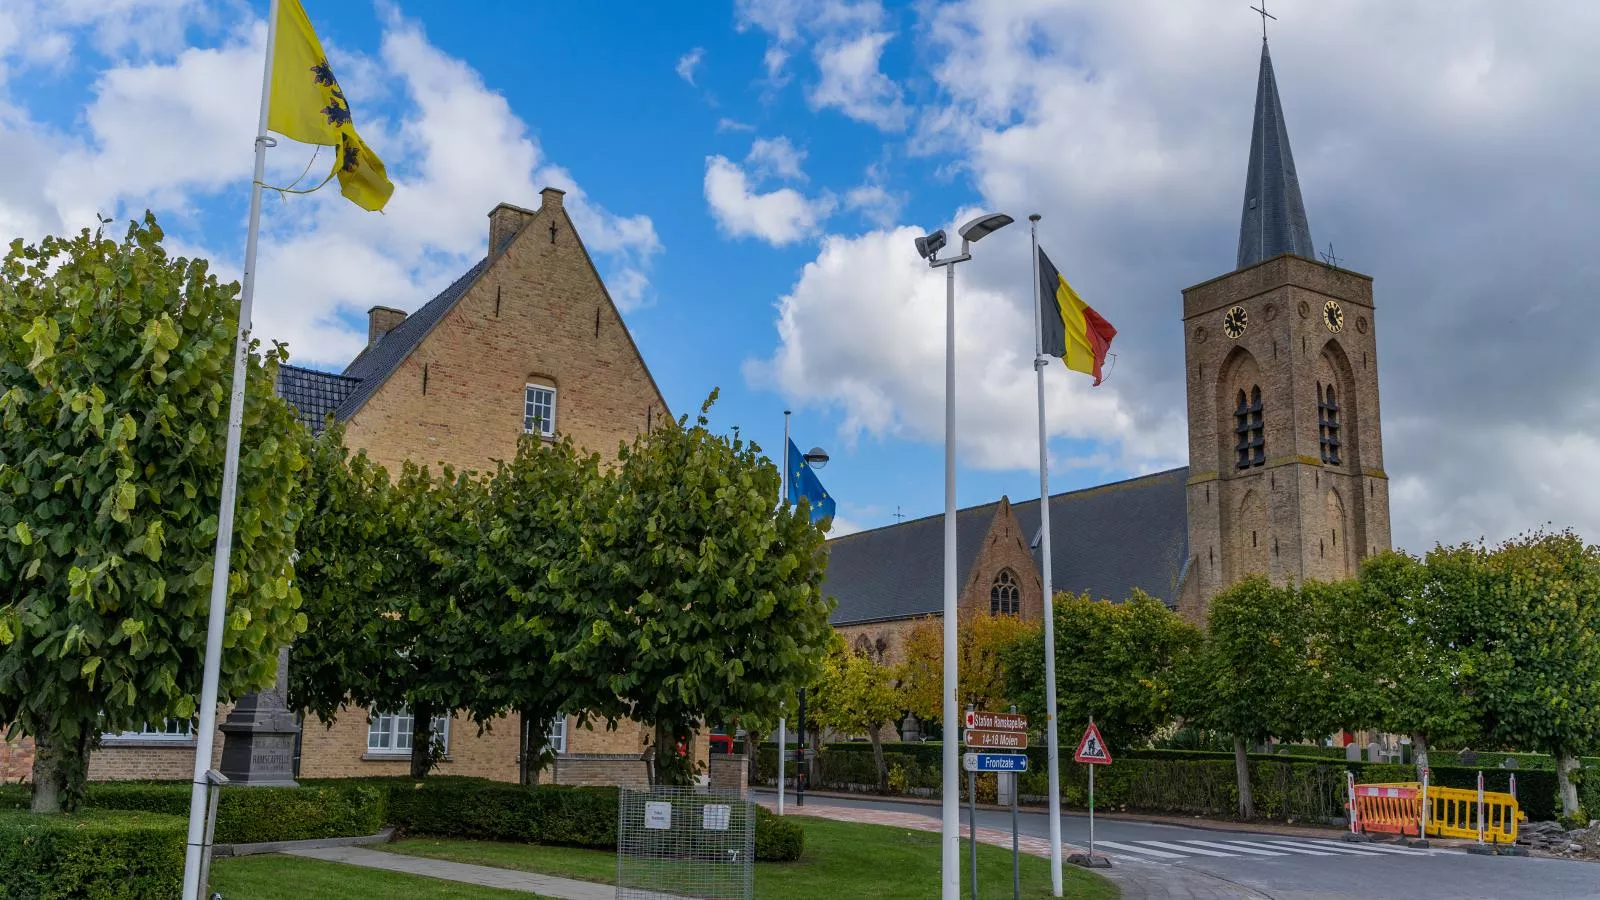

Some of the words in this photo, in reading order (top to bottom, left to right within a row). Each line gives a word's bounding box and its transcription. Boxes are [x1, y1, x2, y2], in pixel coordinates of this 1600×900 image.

[974, 714, 992, 727] Station
[994, 716, 1023, 730] Ramskapelle
[982, 734, 999, 745] 14-18
[1000, 735, 1018, 746] Molen
[985, 756, 1014, 769] Frontzate
